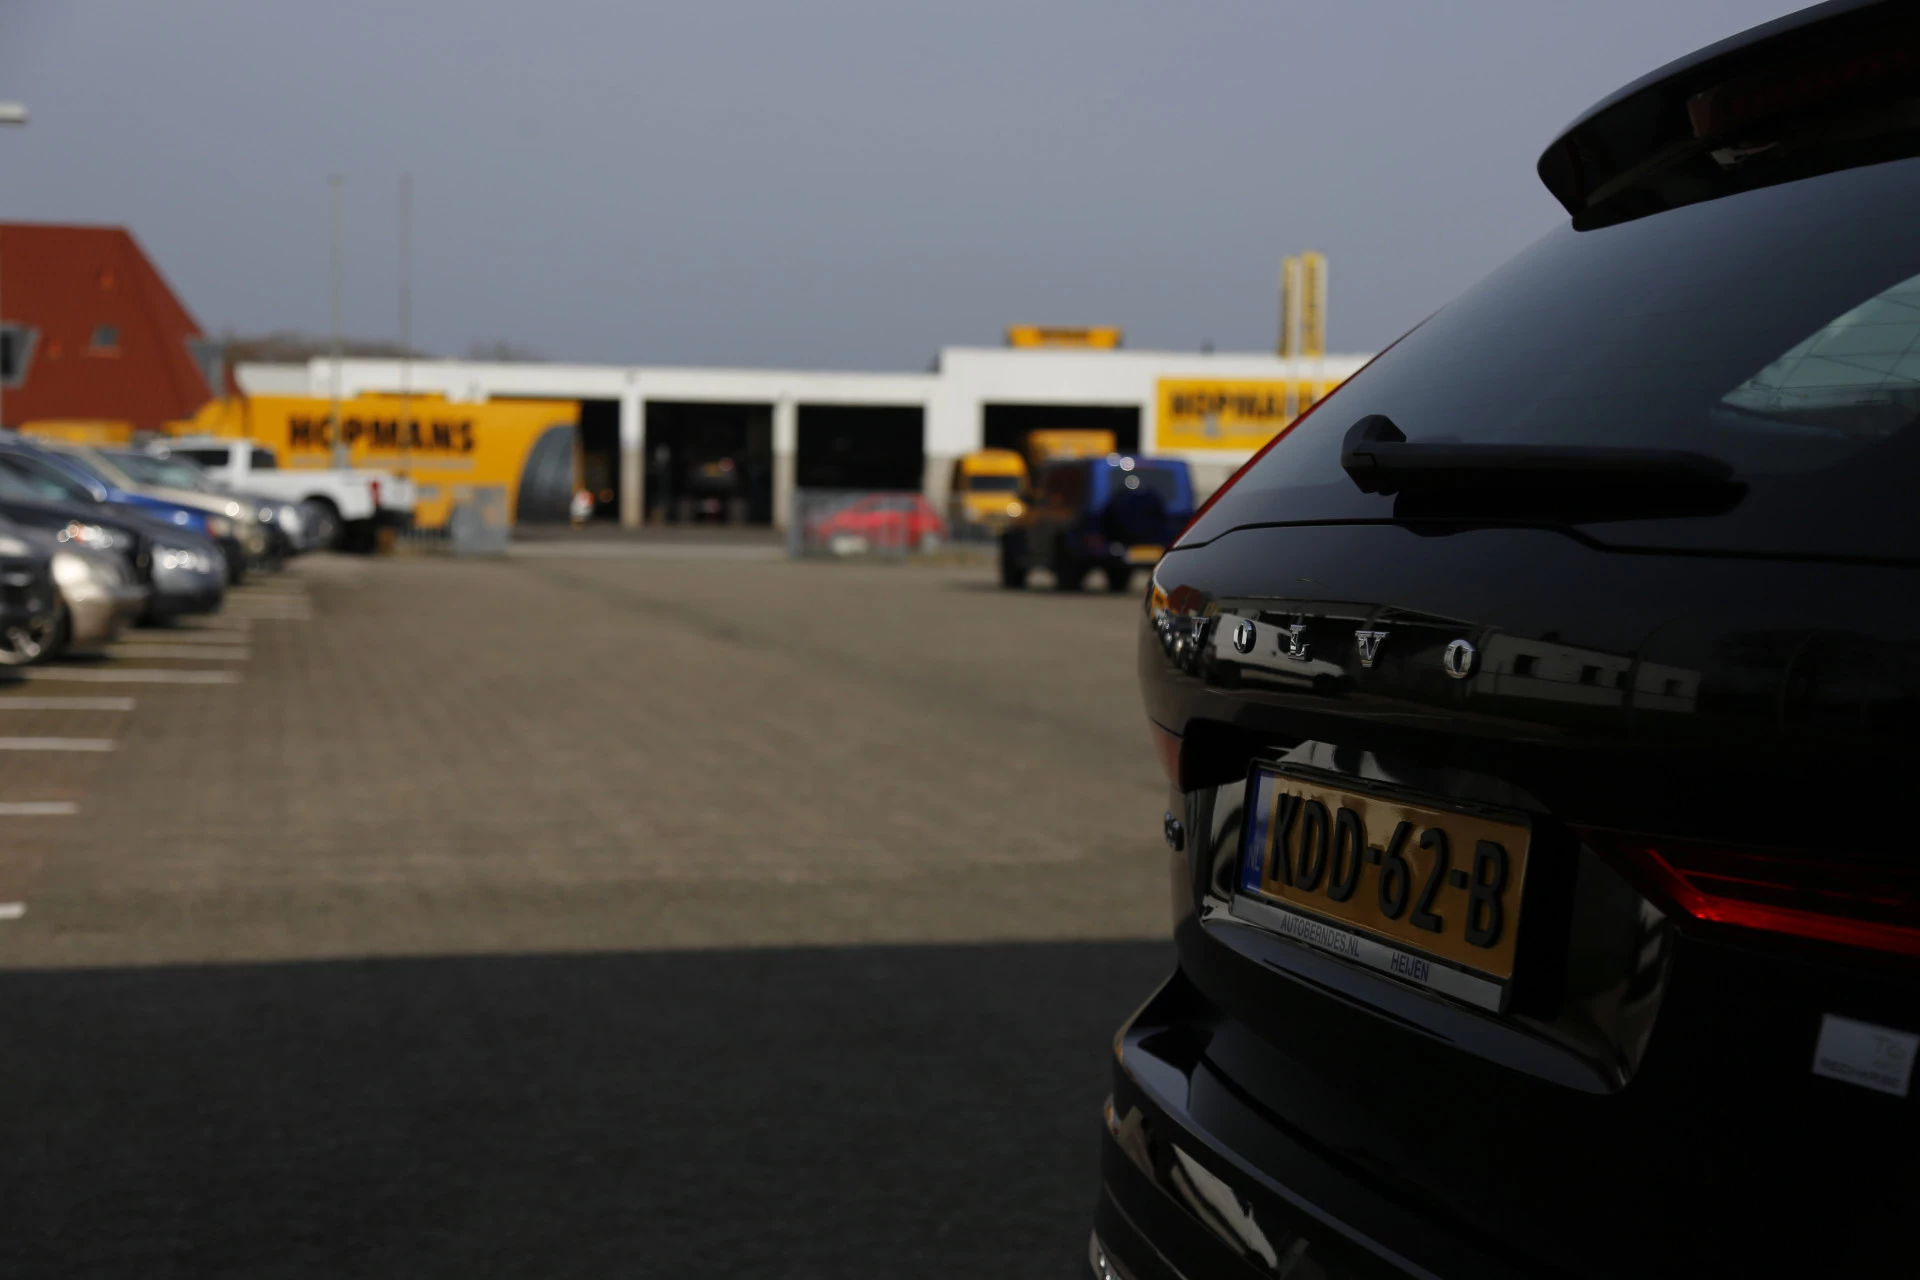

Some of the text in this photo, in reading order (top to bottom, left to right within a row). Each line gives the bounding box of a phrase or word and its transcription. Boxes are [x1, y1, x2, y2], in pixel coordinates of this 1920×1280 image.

[289, 415, 474, 451] HOPMANS
[1191, 616, 1480, 679] VOLVO
[1246, 842, 1261, 872] NL
[1271, 792, 1509, 949] KDD-62-B
[1280, 914, 1360, 958] AUTOBERNDES.NL
[1390, 951, 1430, 982] HEIJEN
